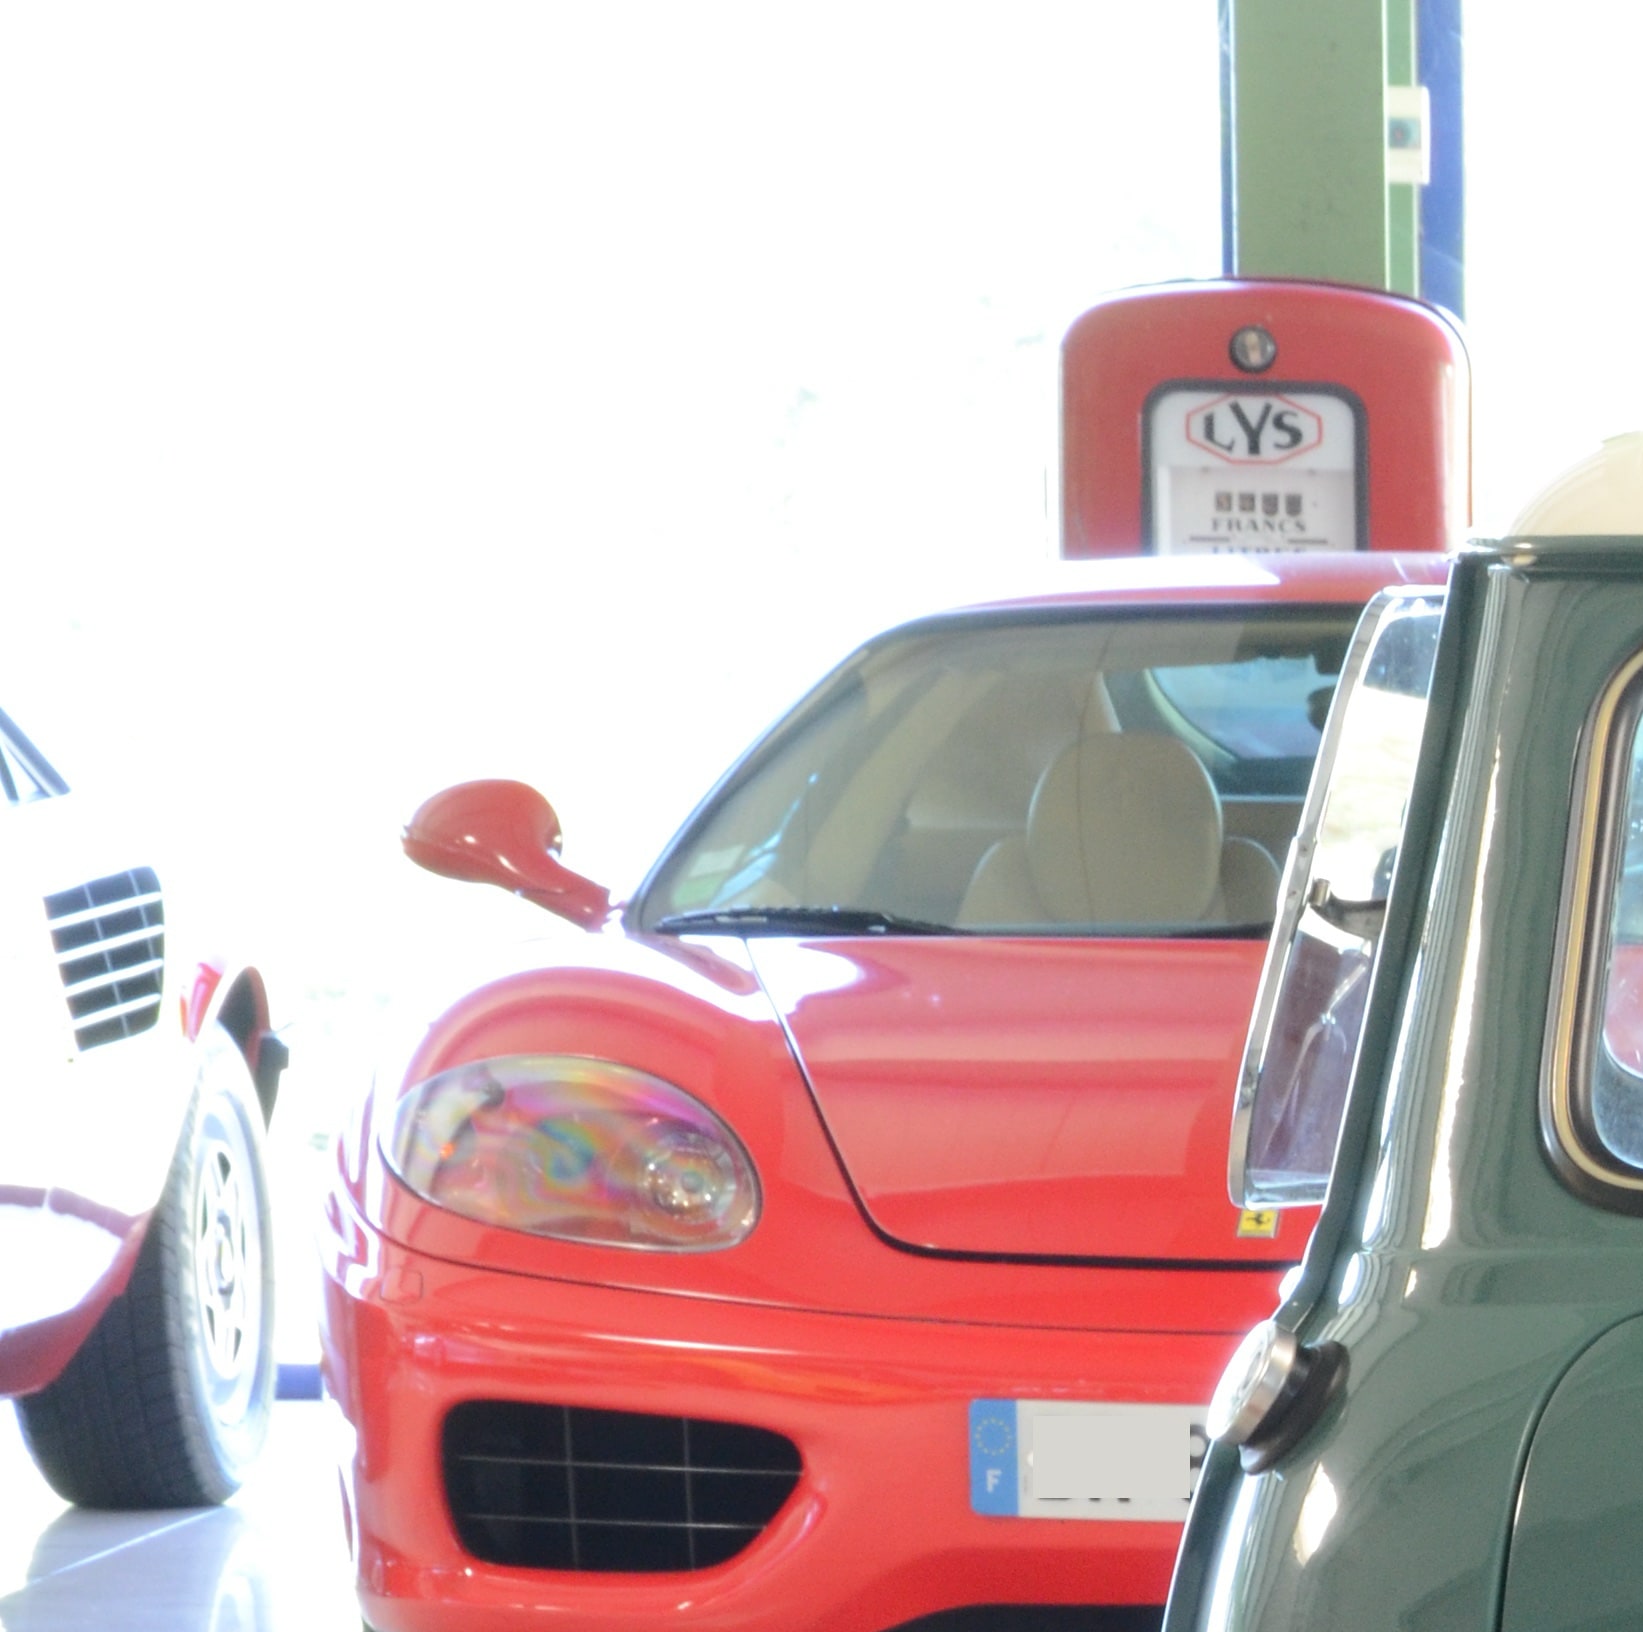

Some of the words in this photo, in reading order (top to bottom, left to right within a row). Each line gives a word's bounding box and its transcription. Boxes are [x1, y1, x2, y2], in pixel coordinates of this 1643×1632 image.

[1203, 401, 1304, 456] LYS
[1211, 517, 1307, 533] FRANCS
[986, 1468, 1003, 1493] F
